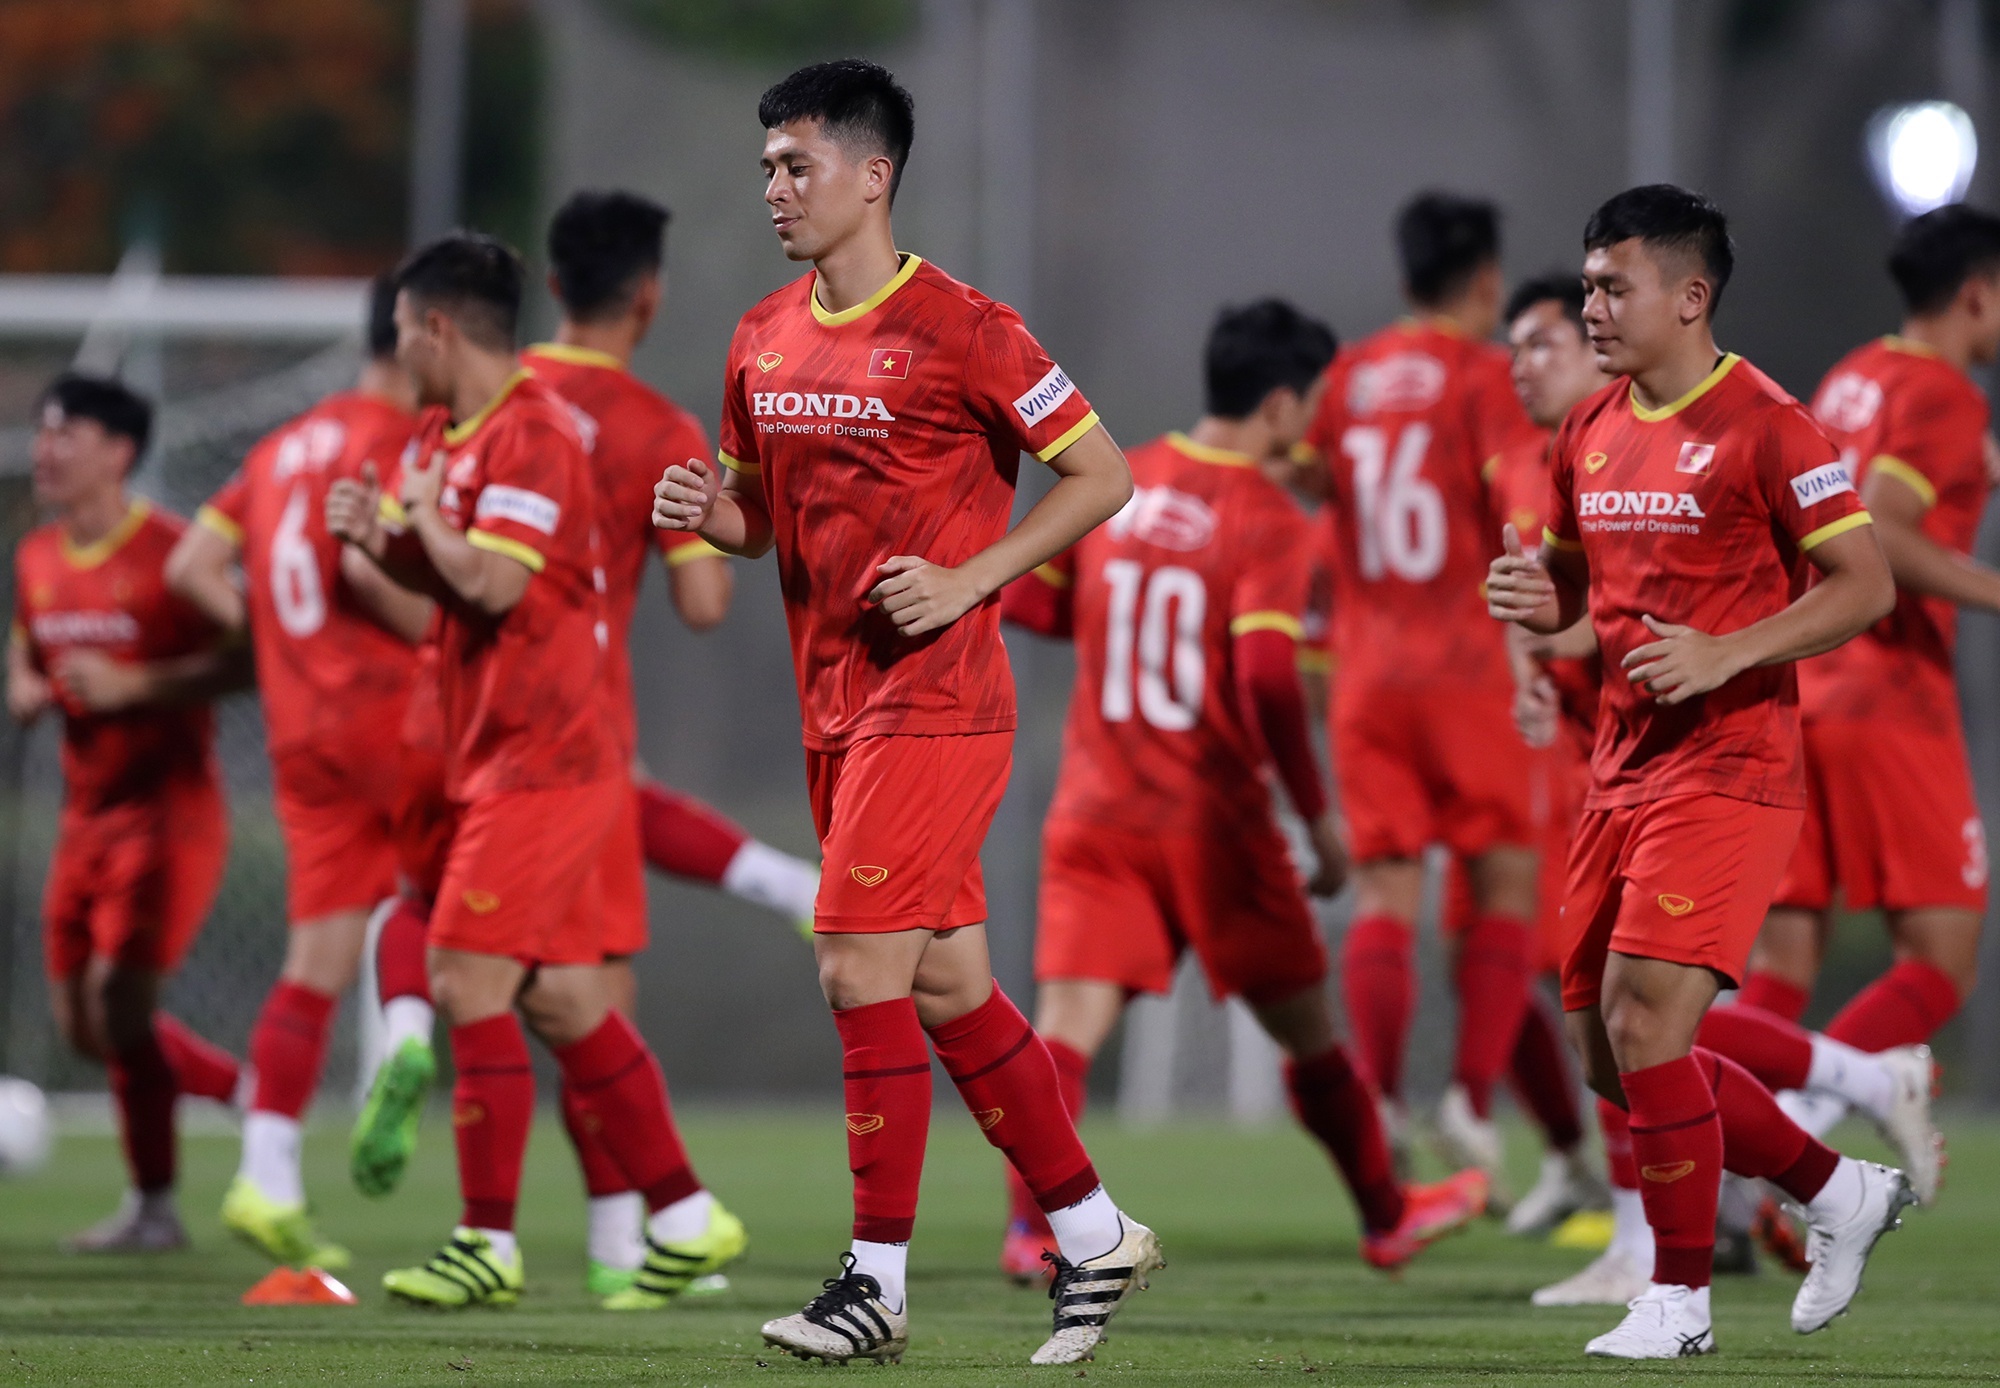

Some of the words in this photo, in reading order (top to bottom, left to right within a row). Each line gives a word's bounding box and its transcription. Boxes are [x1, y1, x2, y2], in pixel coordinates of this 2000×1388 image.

[753, 392, 896, 421] HONDA
[757, 422, 775, 433] The
[776, 421, 815, 435] Power
[817, 423, 832, 435] of
[834, 424, 889, 438] Dreams
[1342, 422, 1449, 582] 16
[1579, 491, 1706, 518] HONDA
[1582, 521, 1597, 532] The
[1598, 519, 1632, 532] Power
[1633, 519, 1647, 531] of
[1648, 520, 1700, 535] Dreams
[270, 488, 327, 637] 6
[1102, 558, 1206, 731] 10
